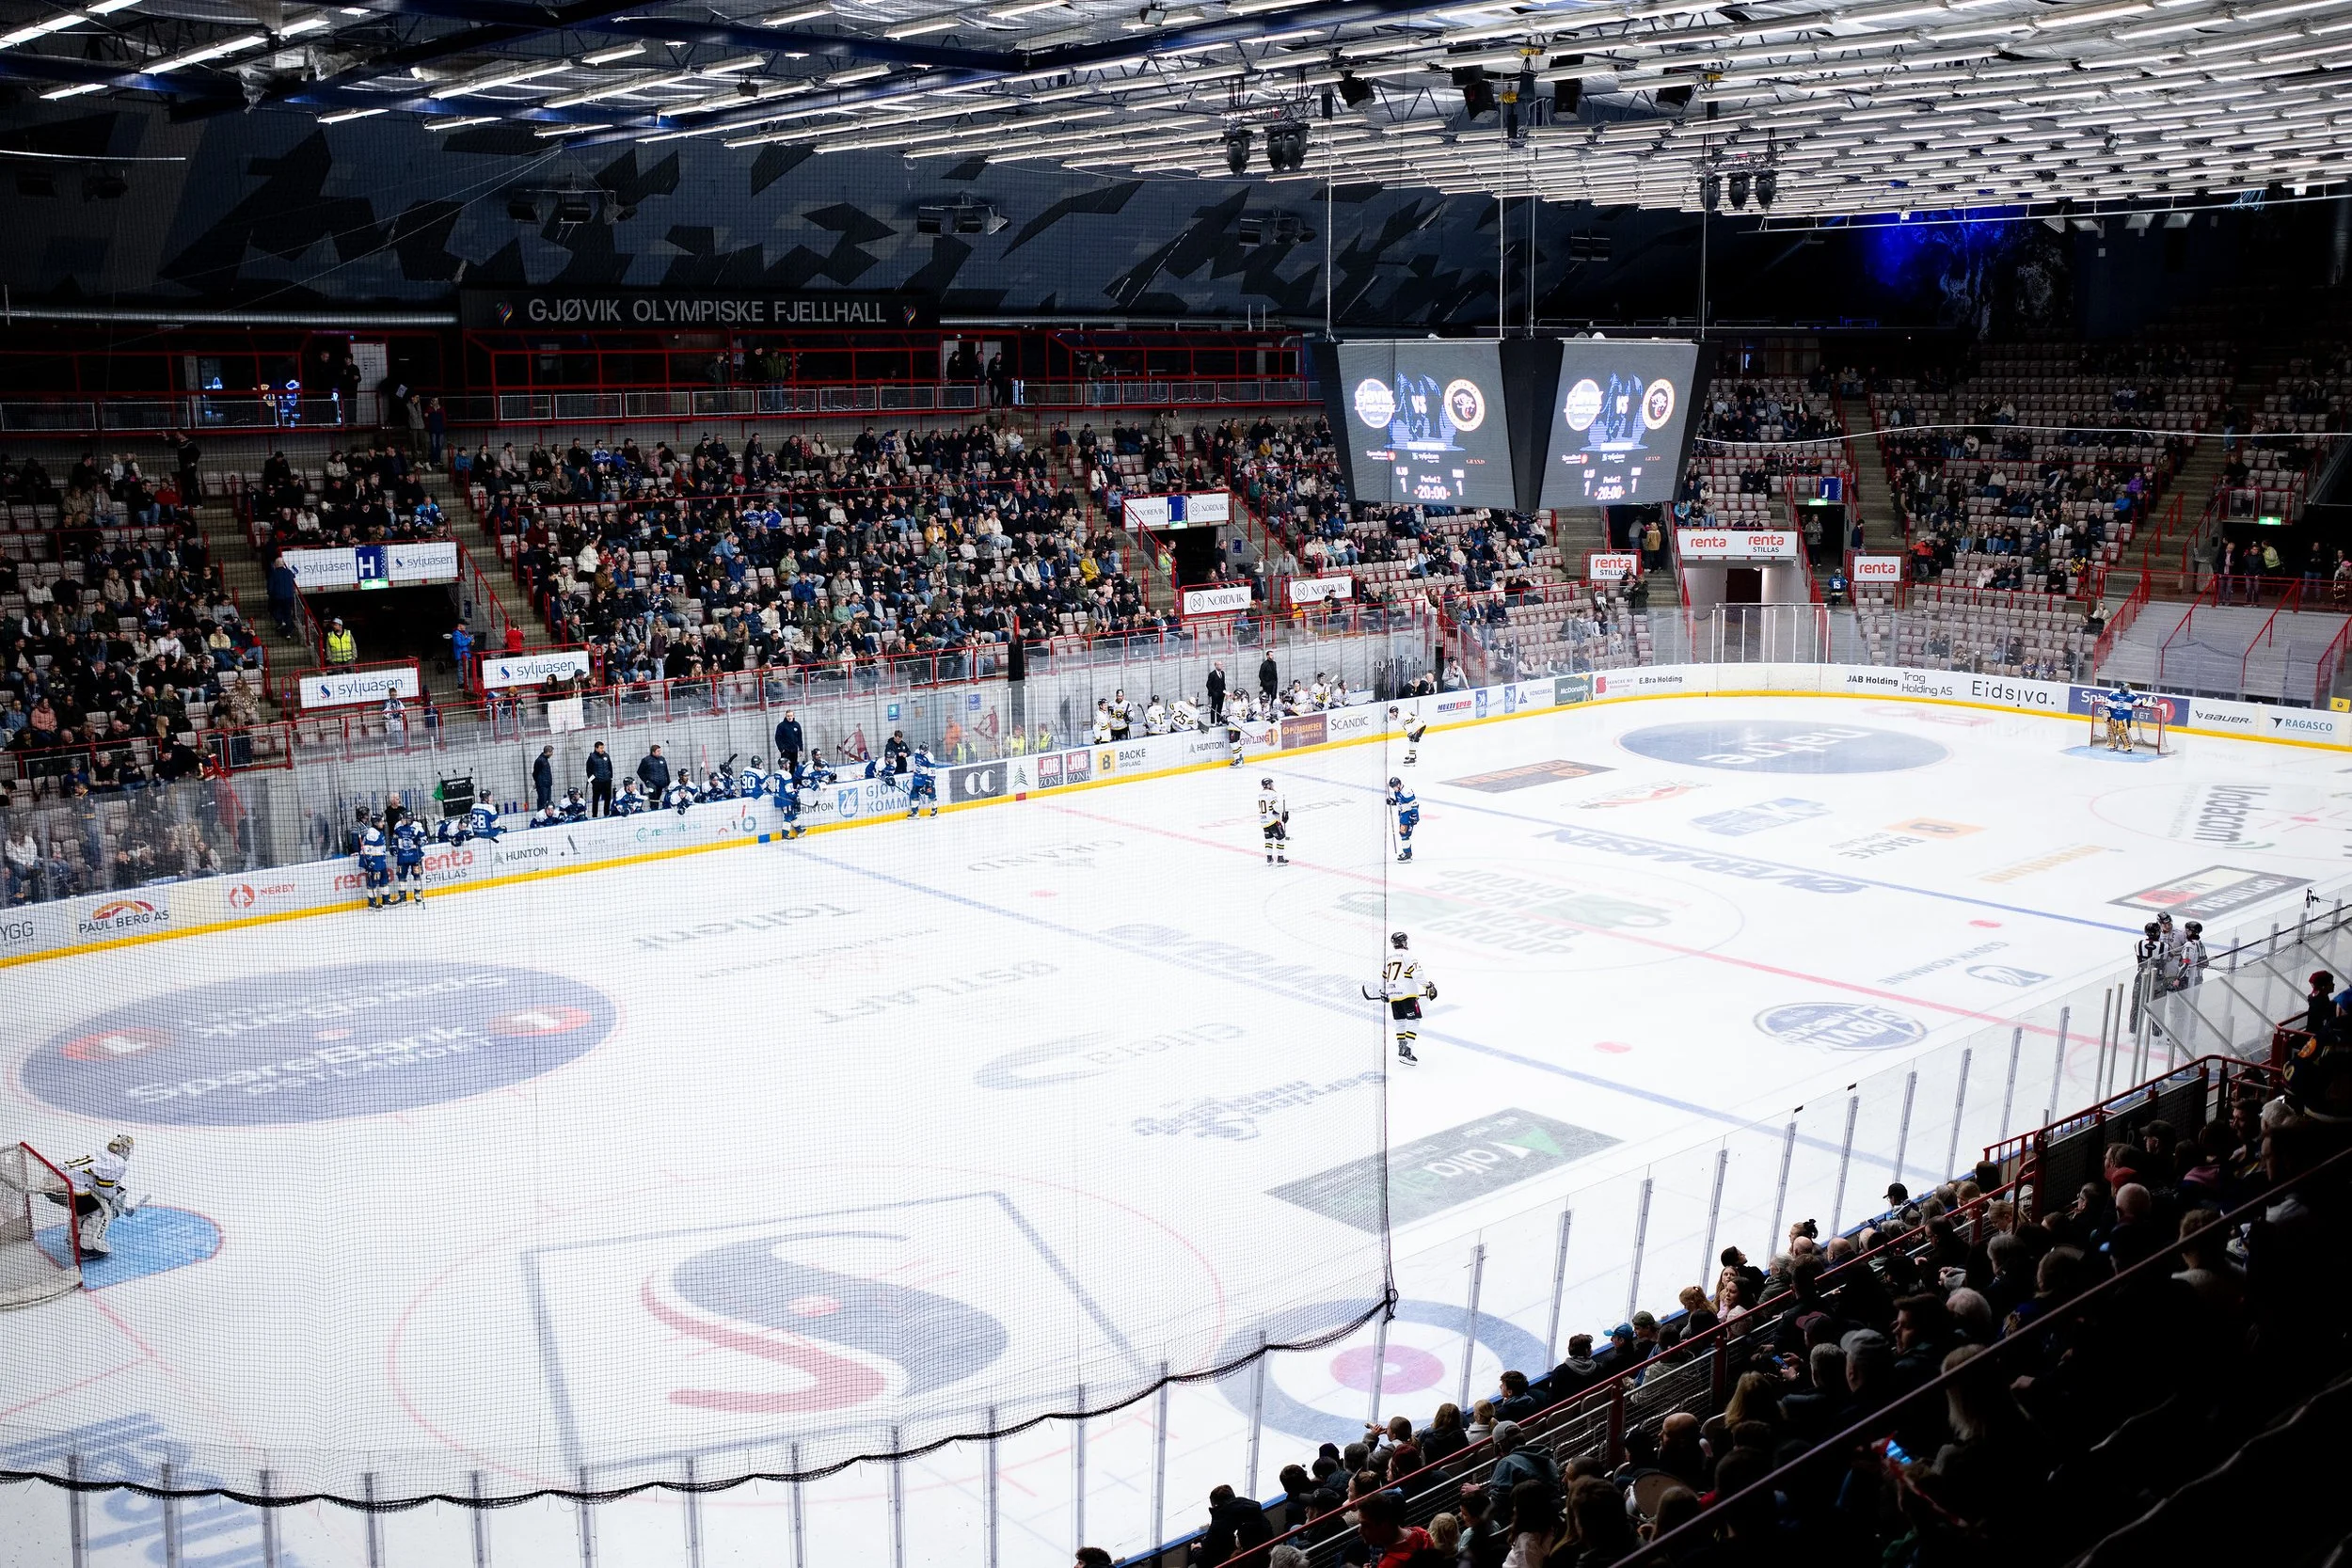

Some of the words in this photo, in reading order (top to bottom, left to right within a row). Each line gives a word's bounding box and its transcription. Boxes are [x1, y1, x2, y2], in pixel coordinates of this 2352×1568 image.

[528, 297, 623, 323] GJØVIK
[632, 299, 765, 322] OLYMPISKE
[773, 300, 887, 324] FJELLHALL
[1412, 395, 1427, 414] VS
[1616, 395, 1629, 414] VS
[1420, 474, 1437, 483] Period
[1417, 484, 1447, 500] 20:00
[1597, 484, 1623, 500] 20:00
[1821, 483, 1829, 499] J
[1200, 503, 1227, 513] NORDVIK
[1690, 536, 1727, 547] renta
[1747, 534, 1785, 546] renta
[303, 560, 354, 576] syljuåsen
[358, 555, 376, 578] H
[406, 554, 454, 569] syljuåsen
[1594, 557, 1633, 569] renta
[1859, 562, 1897, 575] renta
[1598, 568, 1628, 577] STILLAS
[1833, 580, 1841, 590] 15
[1206, 593, 1246, 607] NORDVIK
[516, 658, 577, 678] syljuåsen
[337, 677, 405, 697] syljuåsen
[1639, 676, 1657, 685] E.Bra
[1658, 675, 1683, 685] Holding
[1847, 674, 1864, 684] JAB
[1866, 675, 1899, 688] Holding
[1901, 683, 1938, 697] Holding
[1940, 687, 1953, 696] AS
[1173, 710, 1188, 726] 25
[1330, 716, 1369, 731] SCANDIC
[2284, 718, 2333, 733] RAGASCO
[1196, 740, 1225, 752] HUNTON
[1067, 752, 1089, 771] JOB
[1119, 748, 1147, 761] BACKE
[1039, 757, 1061, 776] JOB
[741, 775, 756, 789] 90
[1039, 774, 1064, 788] ZONE
[1066, 771, 1092, 784] ZONE
[2193, 784, 2272, 843] Vodacom
[471, 814, 487, 829] 28
[424, 848, 475, 872] enta
[505, 846, 549, 863] HUNTON
[424, 867, 469, 885] STILLAS
[260, 882, 296, 896] NERBY
[2194, 879, 2280, 912] OPTIMERA
[78, 919, 114, 935] PAUL
[116, 913, 151, 929] BERG
[153, 909, 170, 922] AS
[1386, 961, 1403, 983] 17
[96, 1218, 108, 1241] CCM
